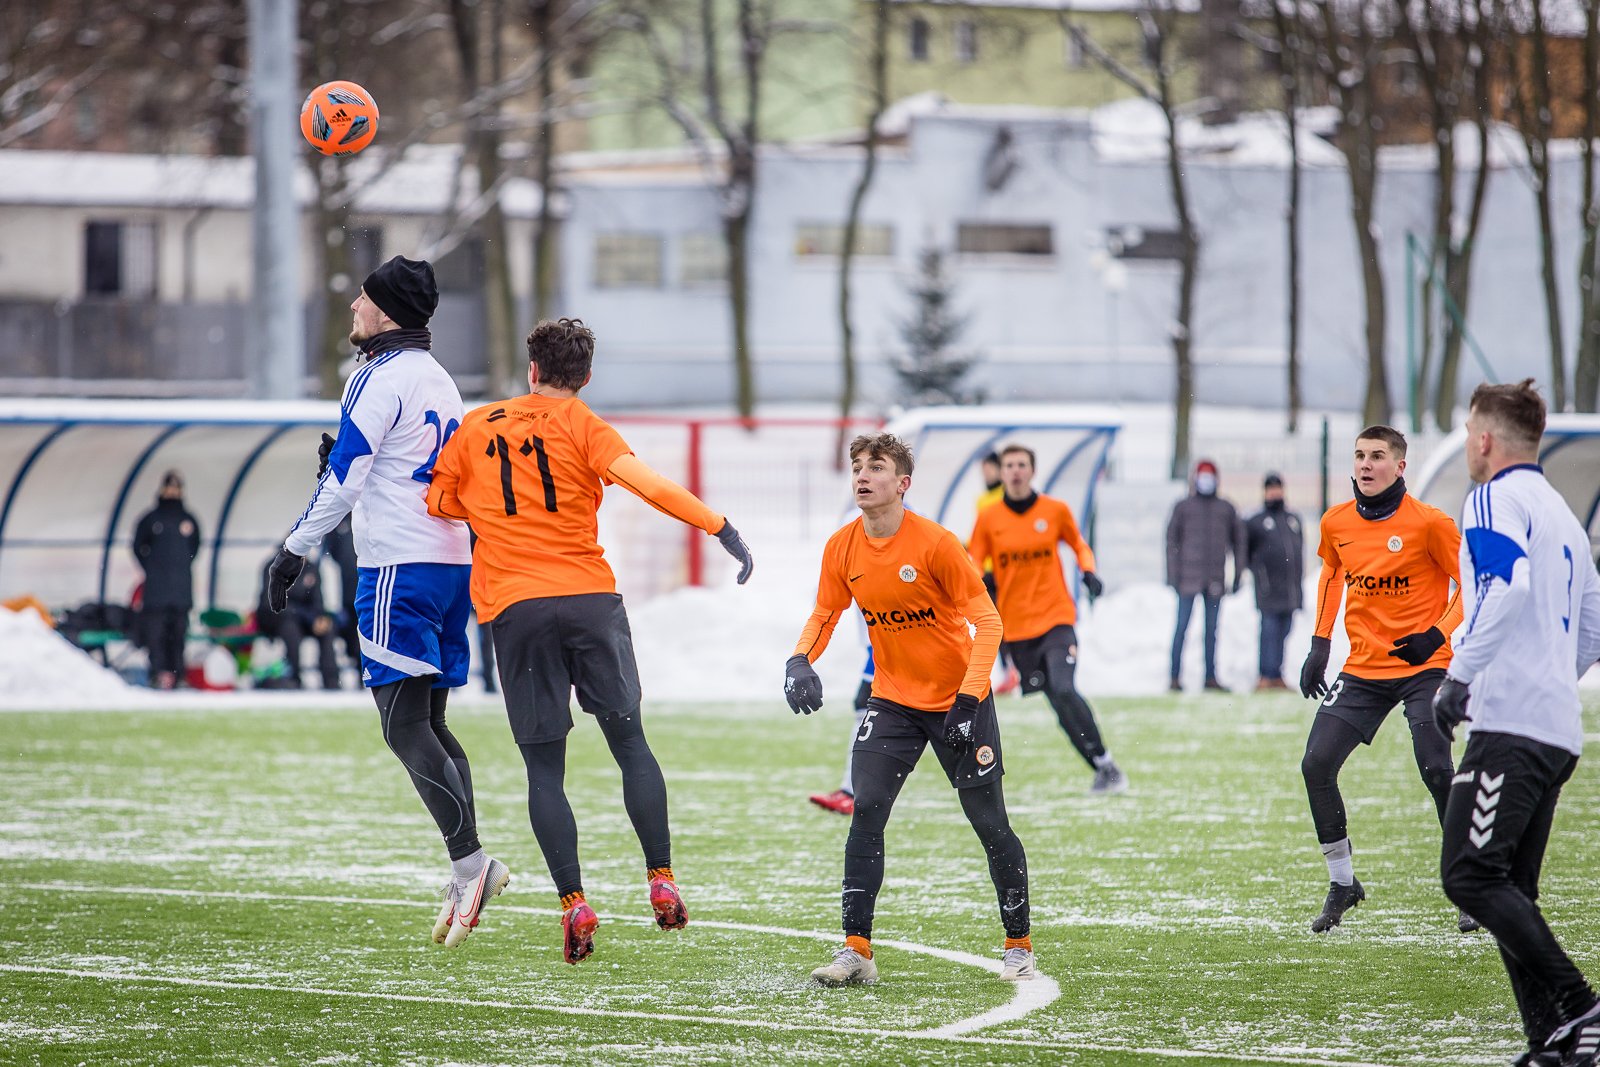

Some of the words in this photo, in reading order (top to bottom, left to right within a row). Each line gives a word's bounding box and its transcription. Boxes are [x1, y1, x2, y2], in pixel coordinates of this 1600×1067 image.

[485, 434, 558, 516] 11
[1355, 575, 1410, 590] KGHM
[876, 607, 936, 626] KGHM
[858, 711, 879, 741] 5
